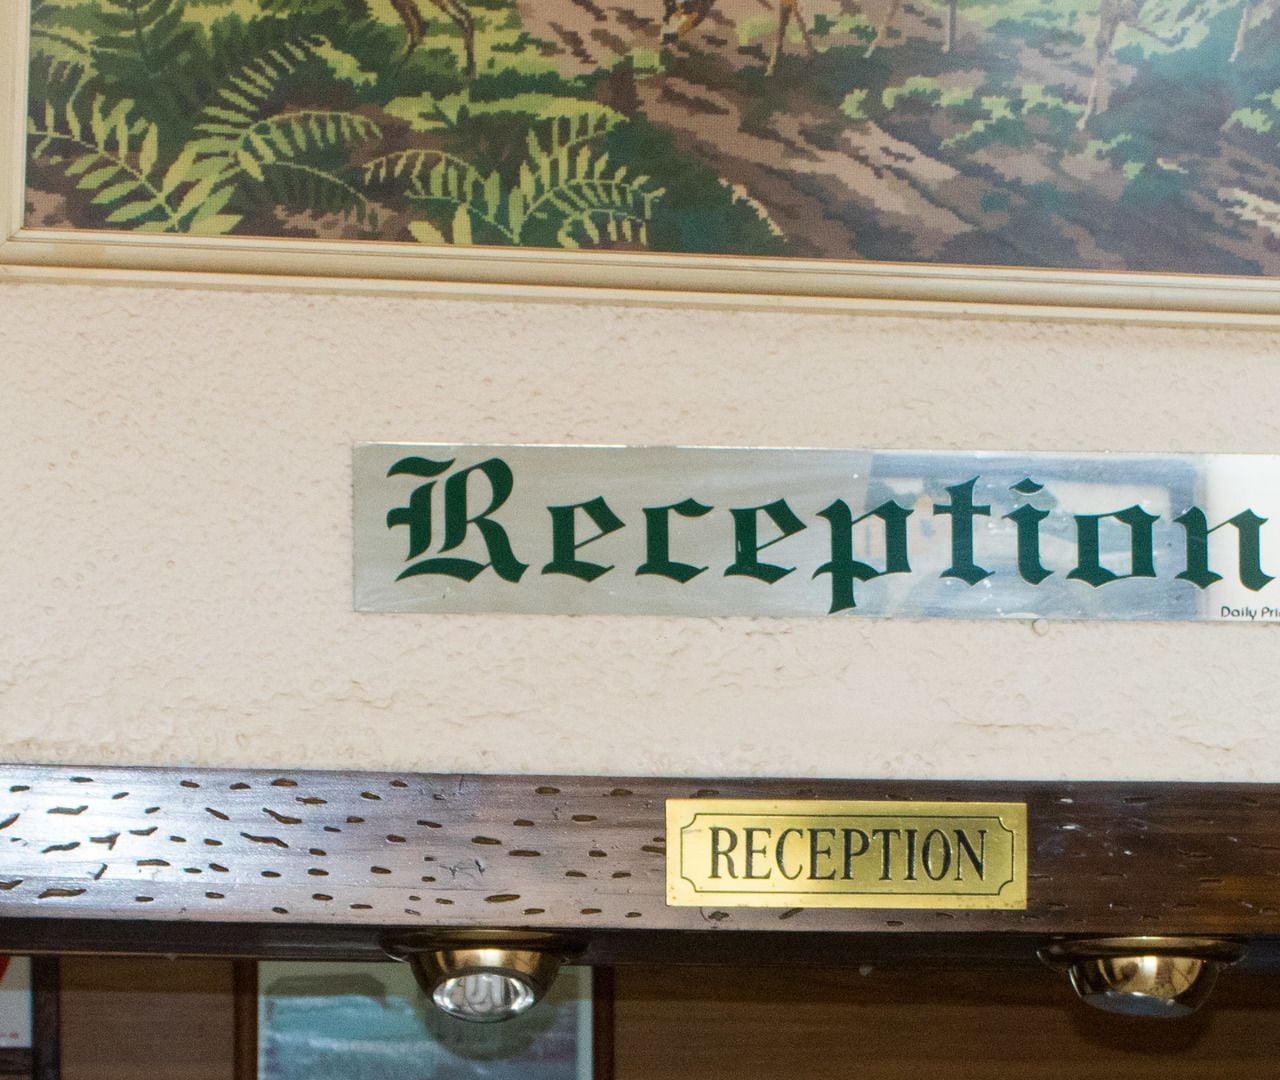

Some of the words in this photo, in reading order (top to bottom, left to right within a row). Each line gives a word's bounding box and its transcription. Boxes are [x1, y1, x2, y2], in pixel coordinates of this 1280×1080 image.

[386, 456, 1275, 614] Reception
[1221, 605, 1257, 621] Daily
[710, 826, 988, 883] RECEPTION
